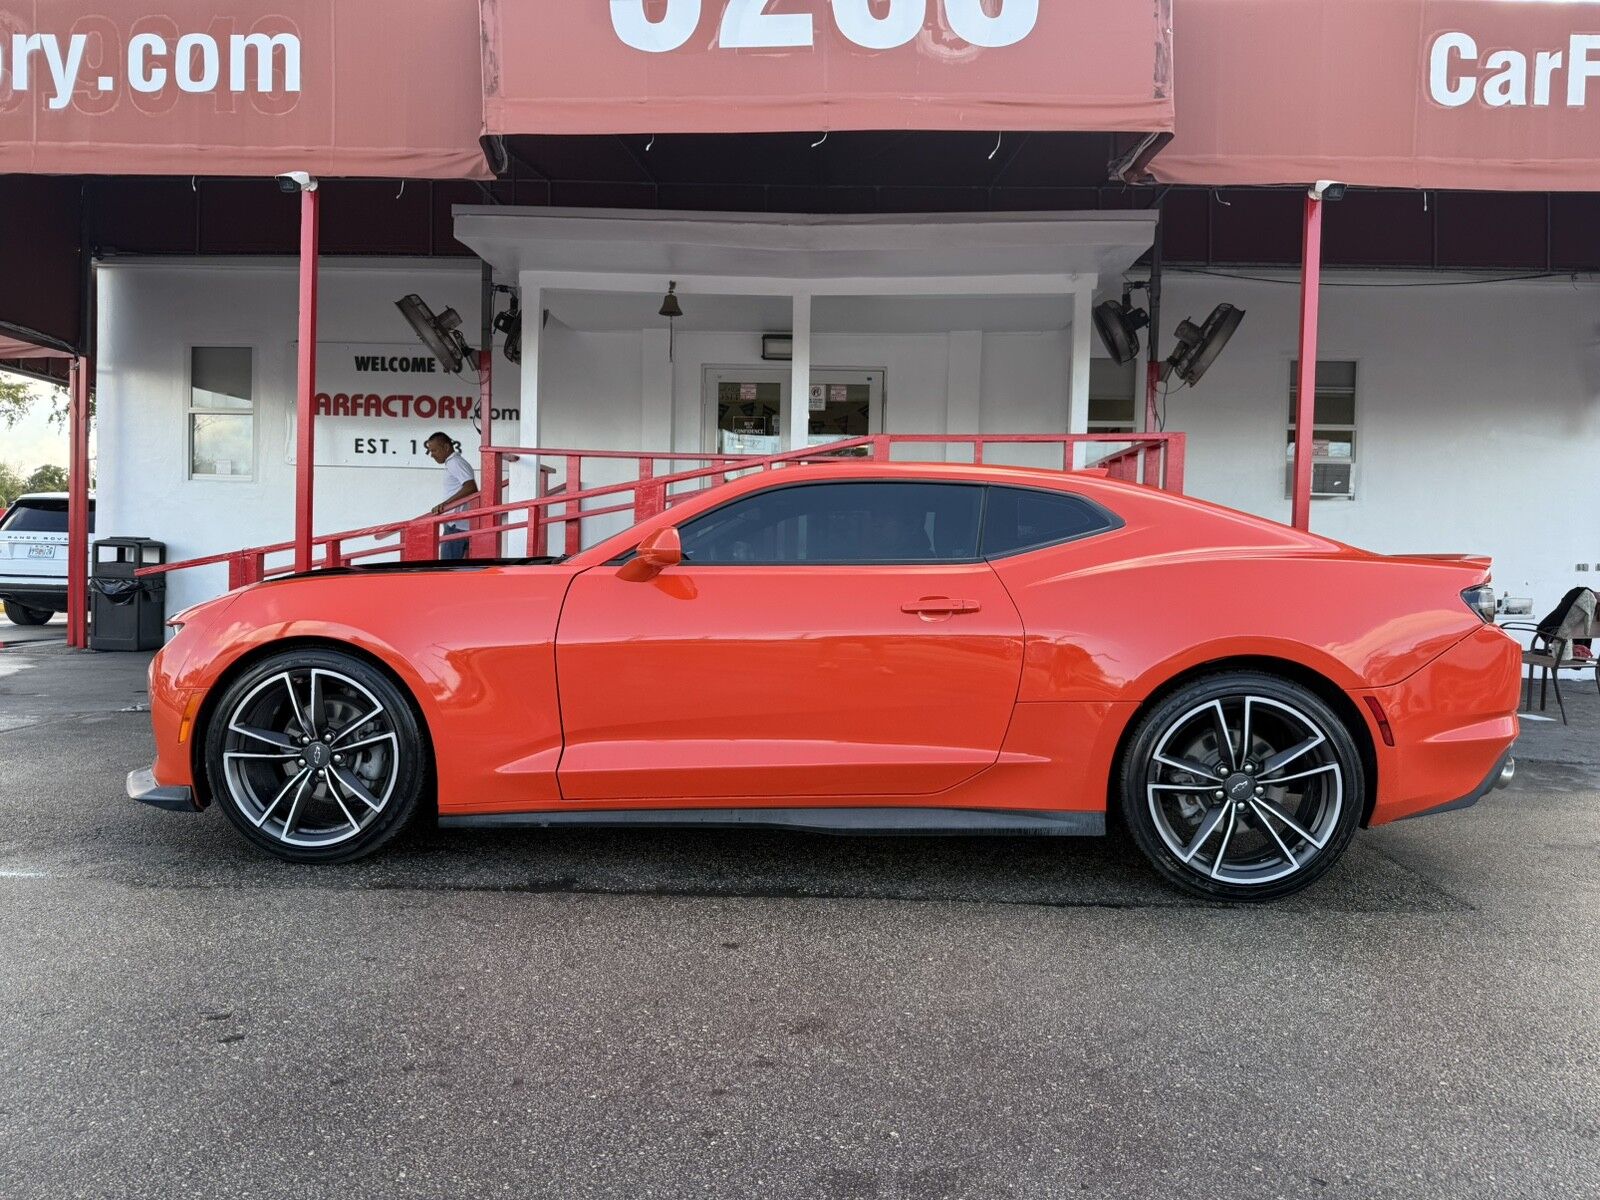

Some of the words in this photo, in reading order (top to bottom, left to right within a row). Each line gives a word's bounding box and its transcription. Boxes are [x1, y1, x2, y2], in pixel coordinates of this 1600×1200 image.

[0, 33, 300, 109] ry.com
[354, 356, 436, 373] WELCOME
[313, 393, 520, 421] ARFACTORY.com
[354, 438, 397, 454] EST.
[410, 438, 463, 455] 193
